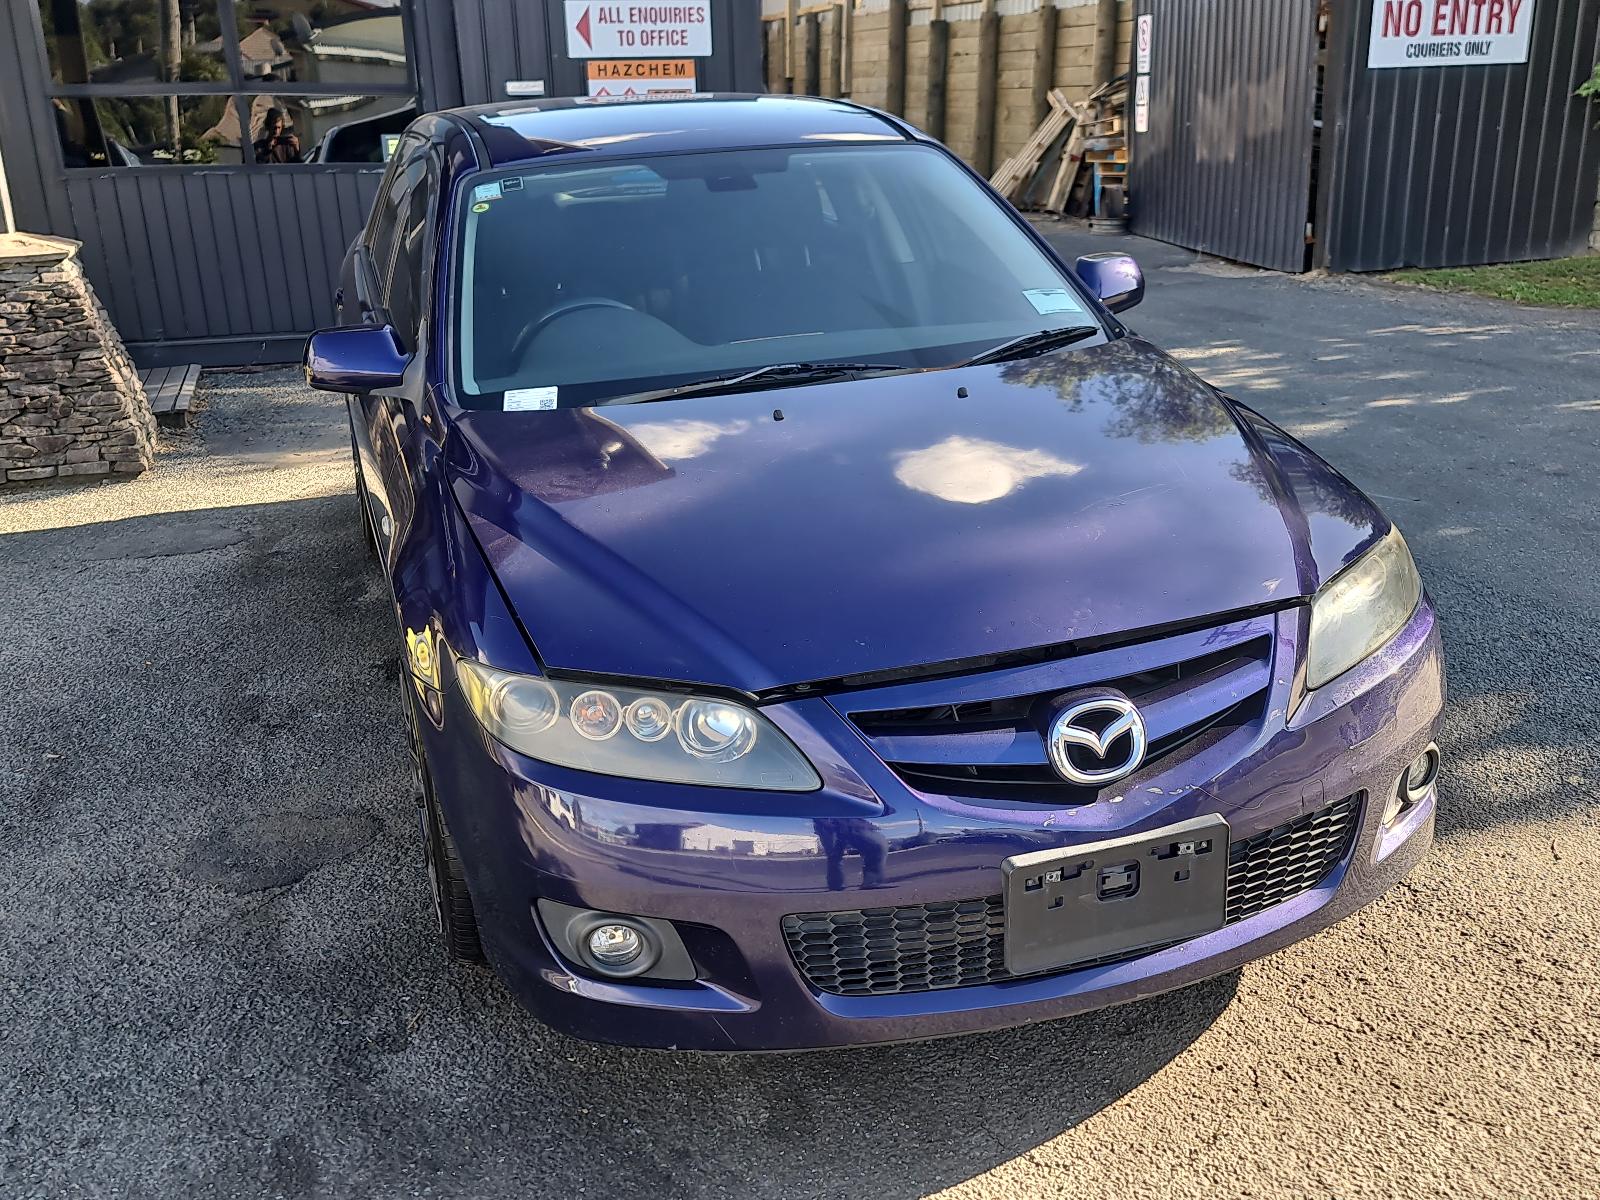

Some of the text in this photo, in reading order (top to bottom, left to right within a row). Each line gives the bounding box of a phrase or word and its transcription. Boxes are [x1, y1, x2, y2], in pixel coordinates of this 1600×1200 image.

[598, 6, 705, 25] ALL ENQUIRIES
[1381, 0, 1521, 37] NO ENTRY
[617, 29, 689, 47] TO OFFICE
[1405, 40, 1493, 58] COURIERS ONLY
[597, 63, 687, 77] HAZCHEM
